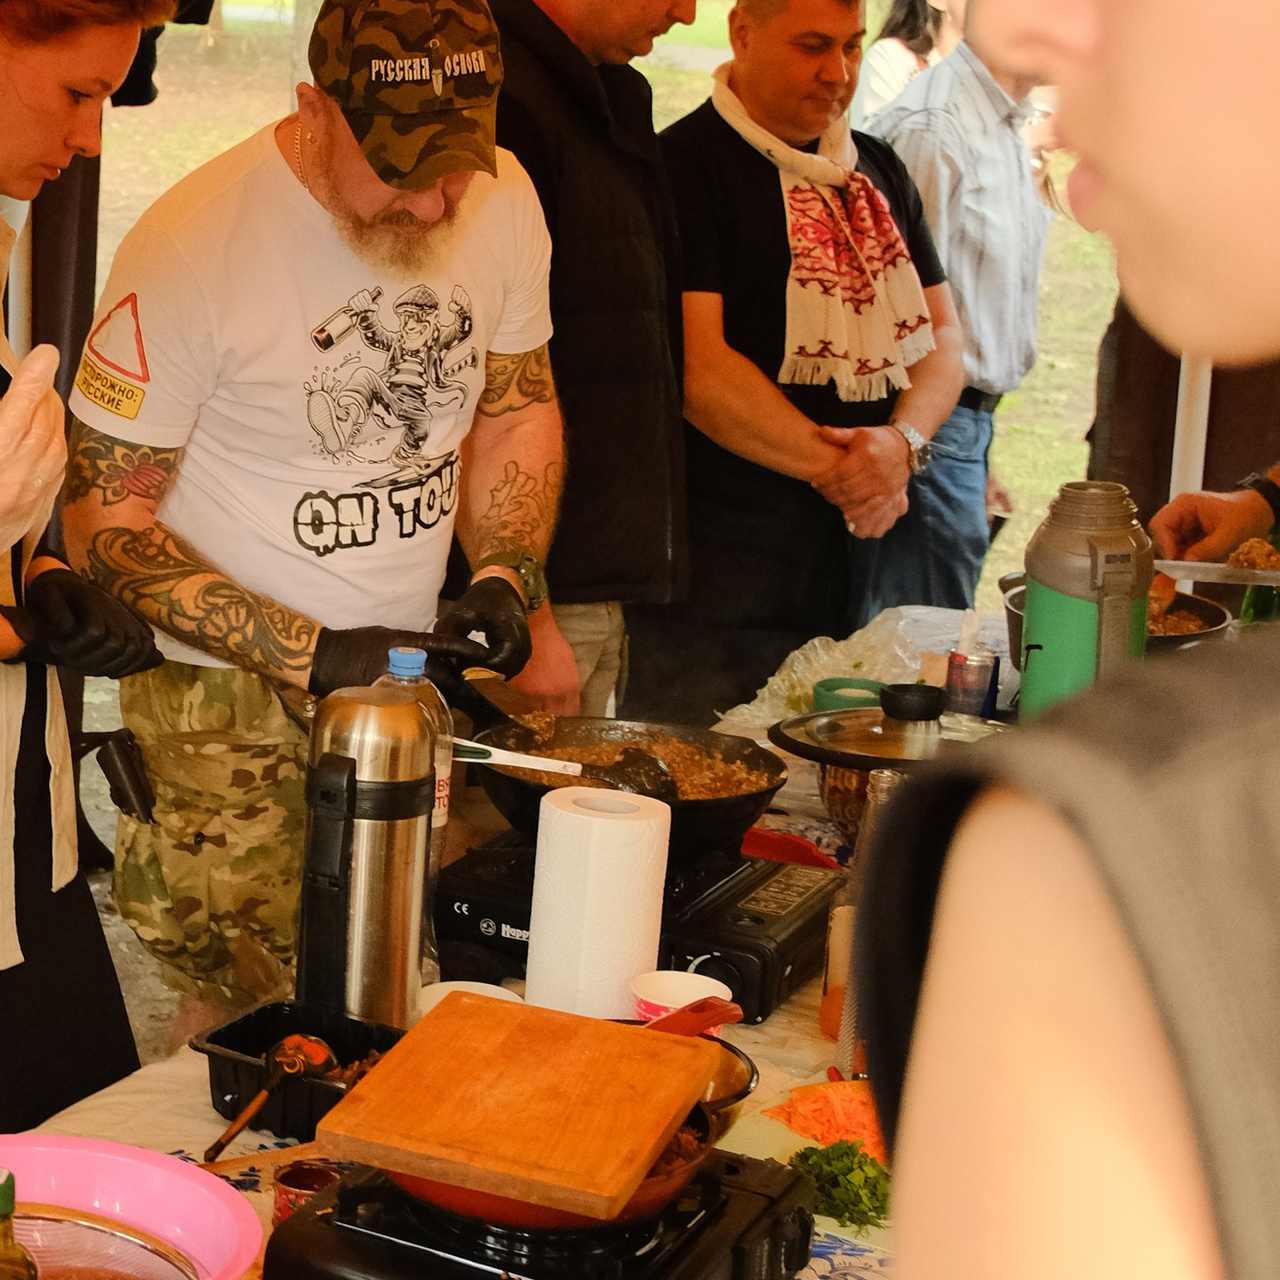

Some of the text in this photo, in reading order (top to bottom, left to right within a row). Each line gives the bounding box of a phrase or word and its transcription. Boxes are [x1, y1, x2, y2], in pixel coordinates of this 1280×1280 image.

[371, 49, 486, 82] РУССКАЯ ОСНОВА
[293, 455, 460, 557] ON TOU
[501, 923, 531, 942] Happ
